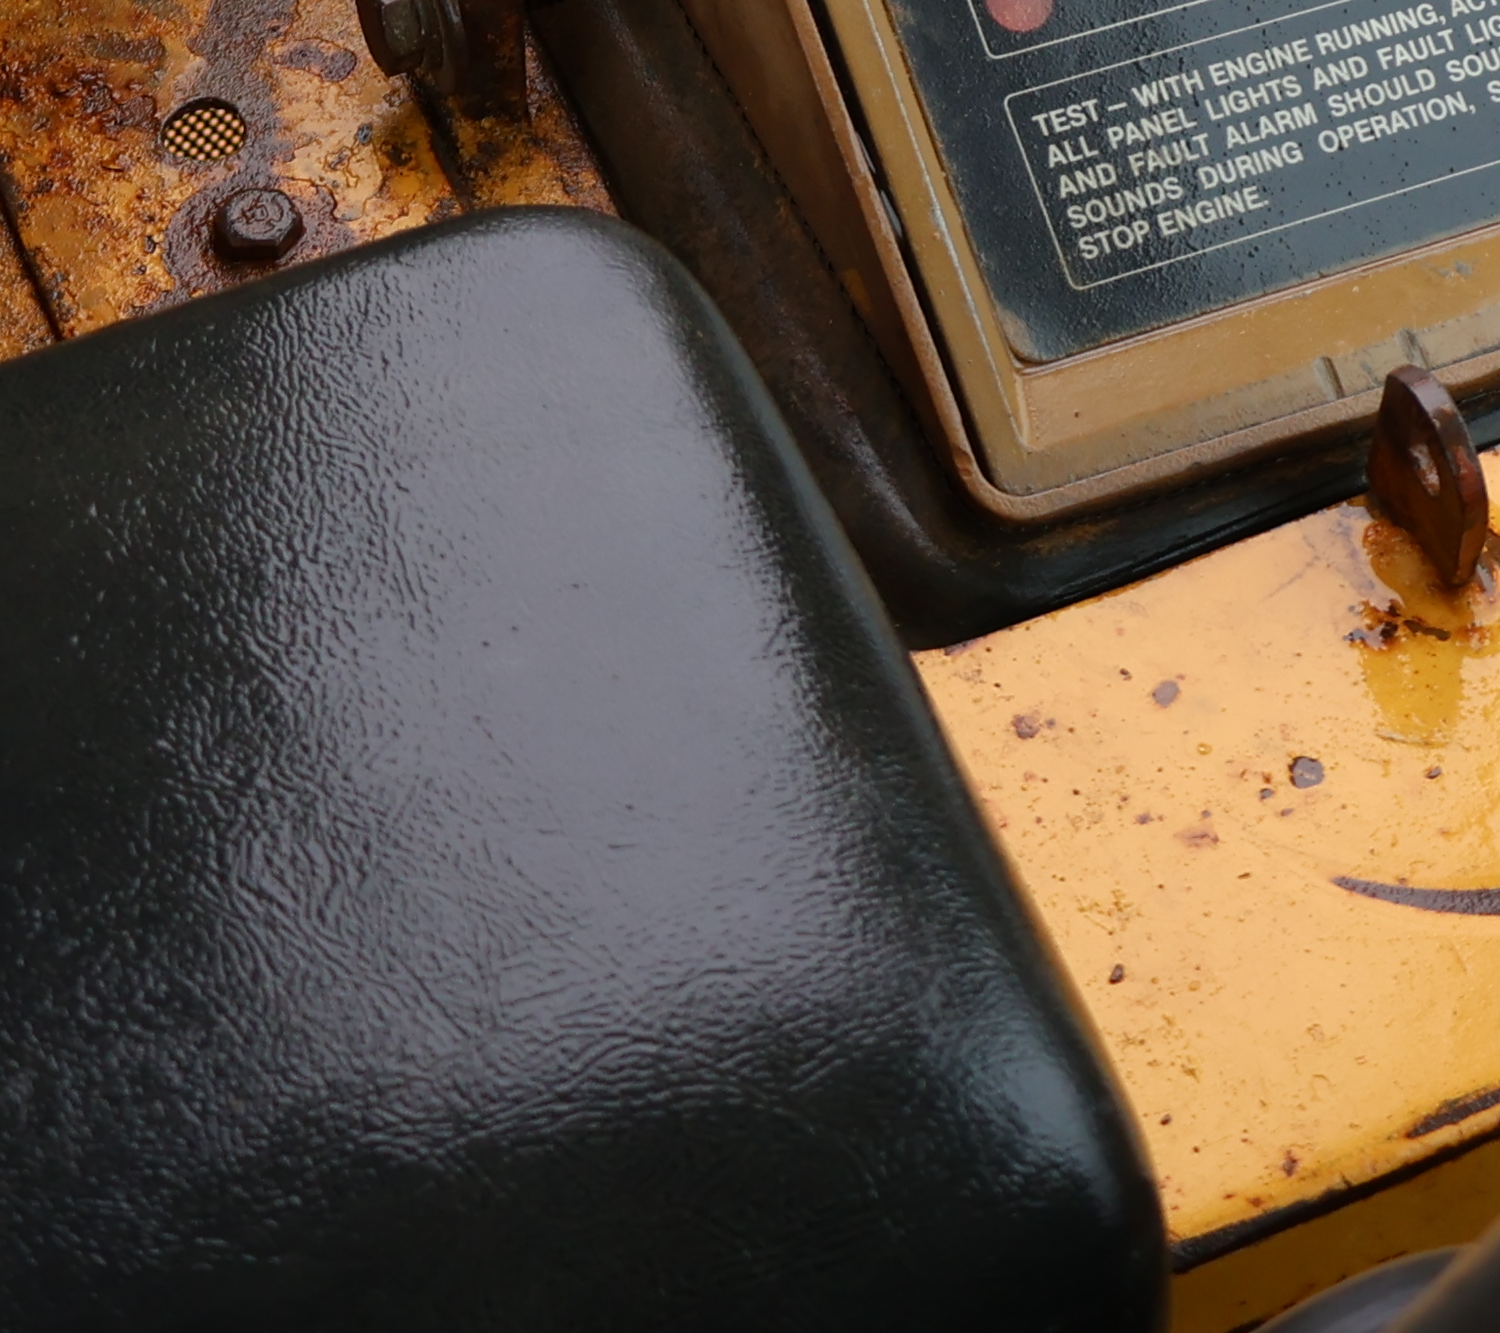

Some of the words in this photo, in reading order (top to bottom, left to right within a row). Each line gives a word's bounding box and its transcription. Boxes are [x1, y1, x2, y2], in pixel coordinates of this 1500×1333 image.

[1032, 99, 1099, 138] TEST
[1131, 69, 1205, 107] WITH
[1208, 38, 1313, 87] ENGINE
[1315, 2, 1447, 56] RUNNING,
[1047, 135, 1099, 169] ALL
[1107, 107, 1198, 151] PANEL
[1204, 74, 1302, 122] LIGHTS
[1313, 55, 1369, 91] AND
[1376, 28, 1454, 71] FAULT
[1058, 162, 1116, 199] AND
[1131, 133, 1212, 179] FAULT
[1226, 101, 1319, 149] ALARM
[1327, 67, 1436, 118] SHOULD
[1066, 176, 1184, 230] SOUNDS
[1198, 141, 1304, 191] DURING
[1318, 91, 1476, 153] OPERATION,
[1078, 219, 1151, 261] STOP
[1157, 185, 1269, 238] ENGINE.
